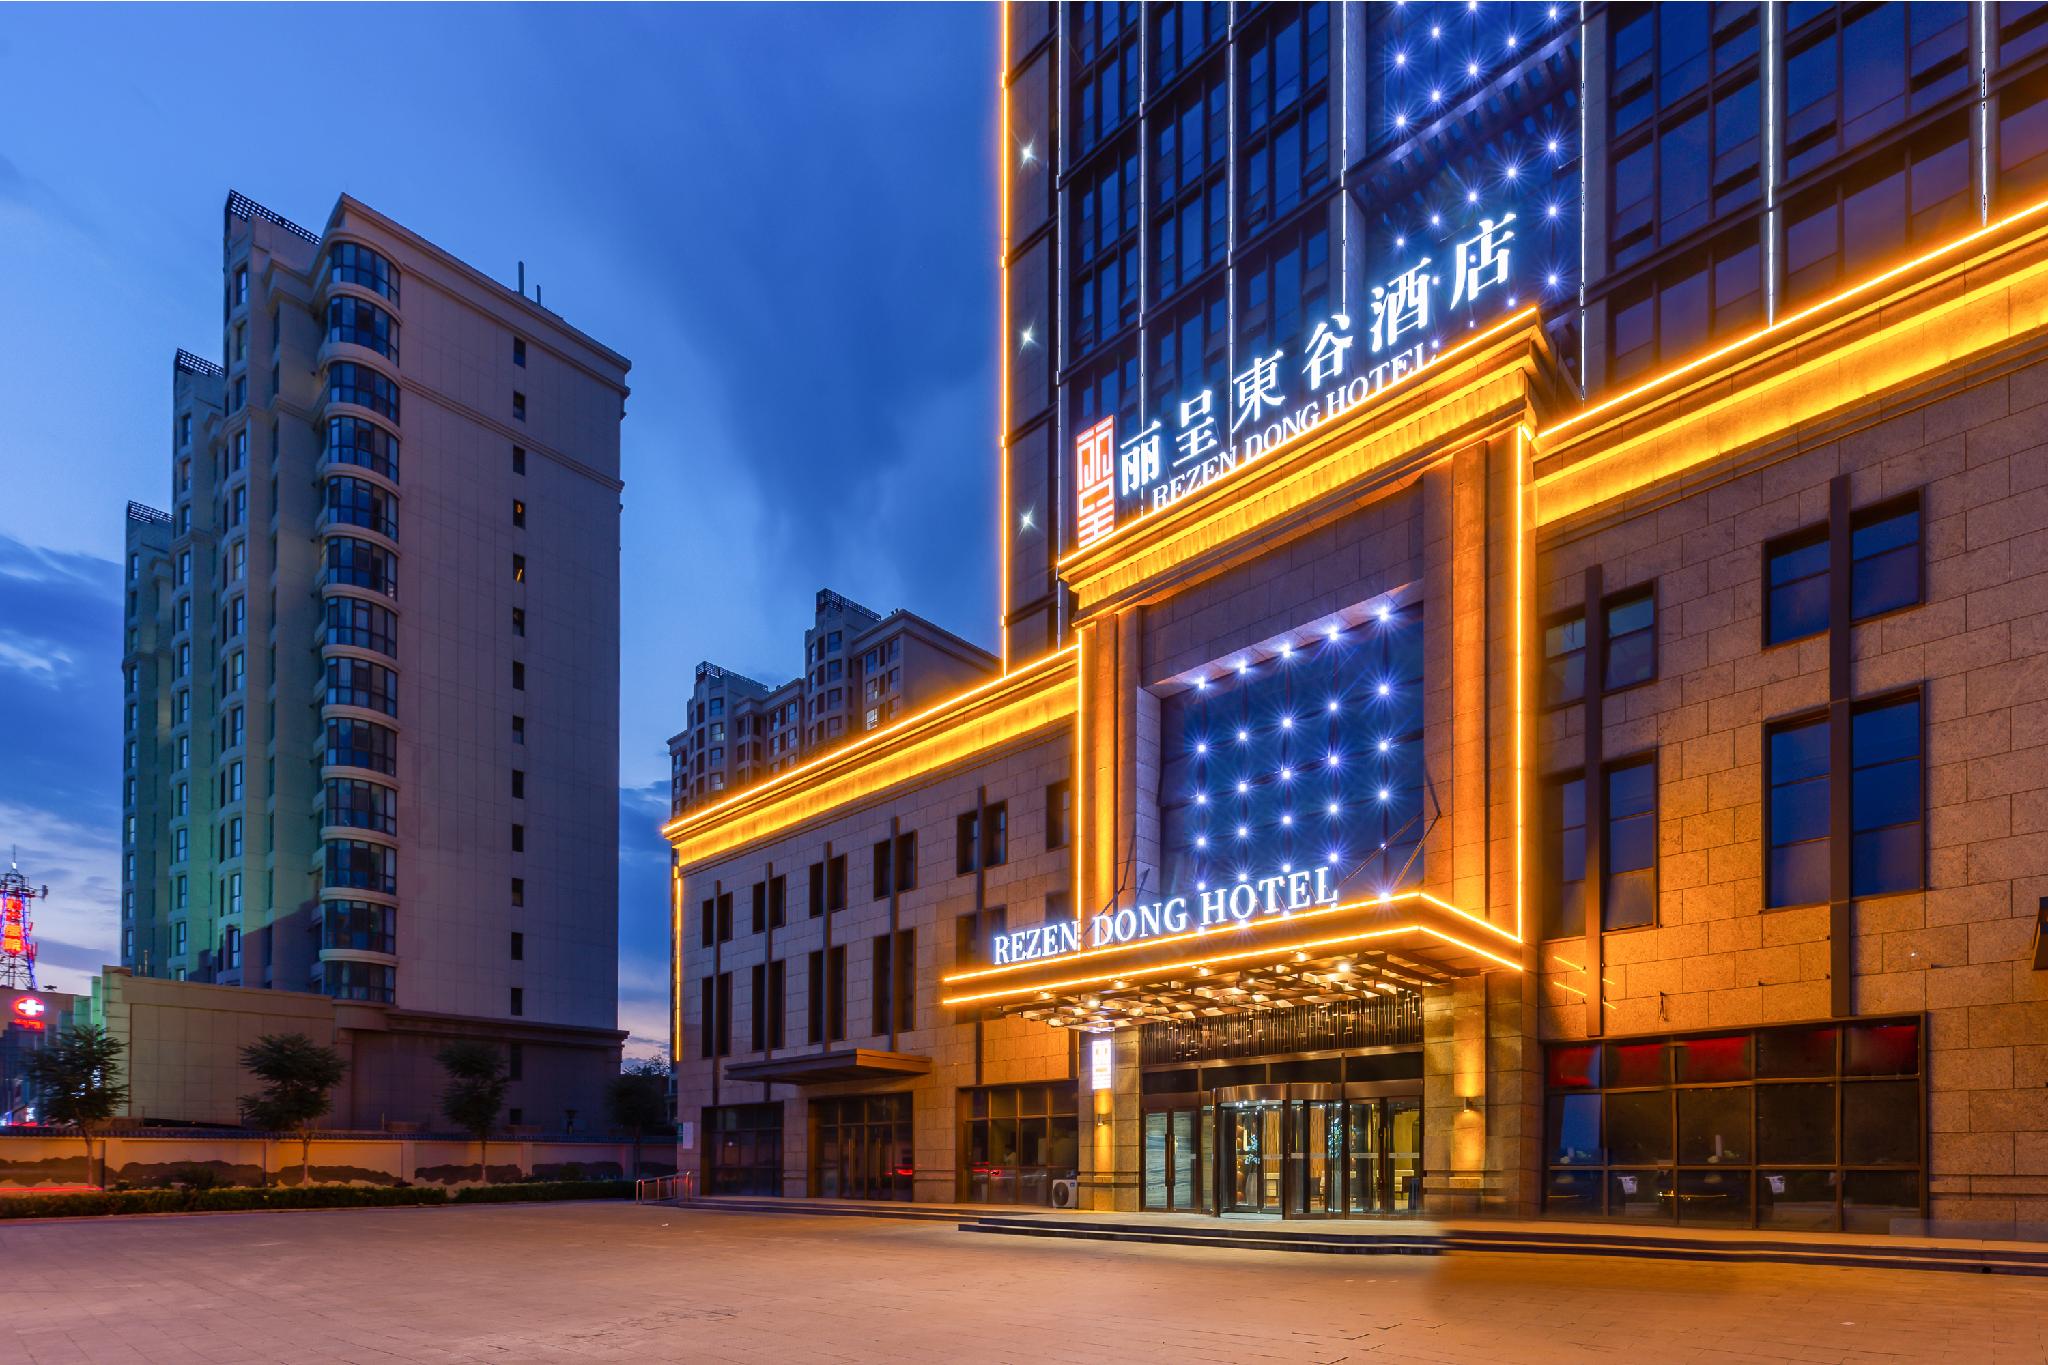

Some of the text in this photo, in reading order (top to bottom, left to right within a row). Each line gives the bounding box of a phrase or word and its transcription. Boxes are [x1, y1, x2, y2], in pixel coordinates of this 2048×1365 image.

[1119, 212, 1517, 496] 丽呈東谷酒店
[1152, 342, 1438, 513] REZEN DONG HOTEL
[994, 866, 1339, 965] REZEN DONG HOTEL
